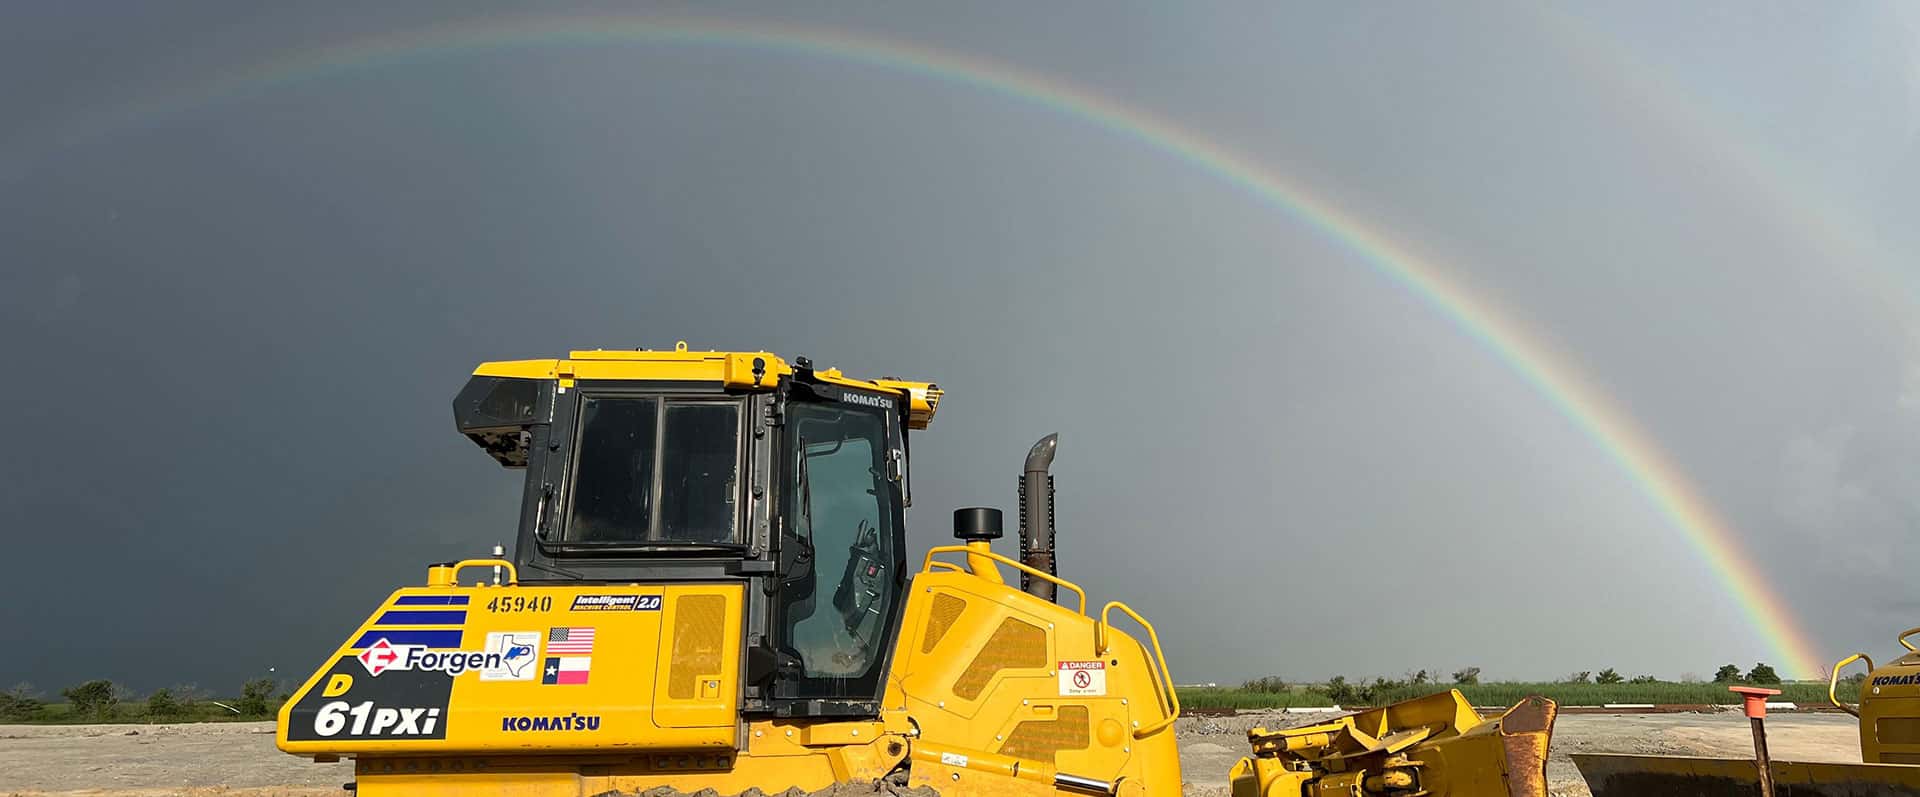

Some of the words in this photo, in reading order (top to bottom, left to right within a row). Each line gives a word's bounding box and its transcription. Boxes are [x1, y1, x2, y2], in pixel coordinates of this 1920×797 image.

[843, 393, 893, 408] KOMATSU
[487, 596, 552, 613] 45940
[575, 596, 636, 606] Intelligent
[638, 597, 660, 609] 2.0
[405, 647, 501, 673] Forgen
[321, 673, 354, 698] D
[1872, 673, 1920, 686] KOMATS
[313, 701, 441, 737] 61PXi
[502, 712, 601, 732] KOMATSU
